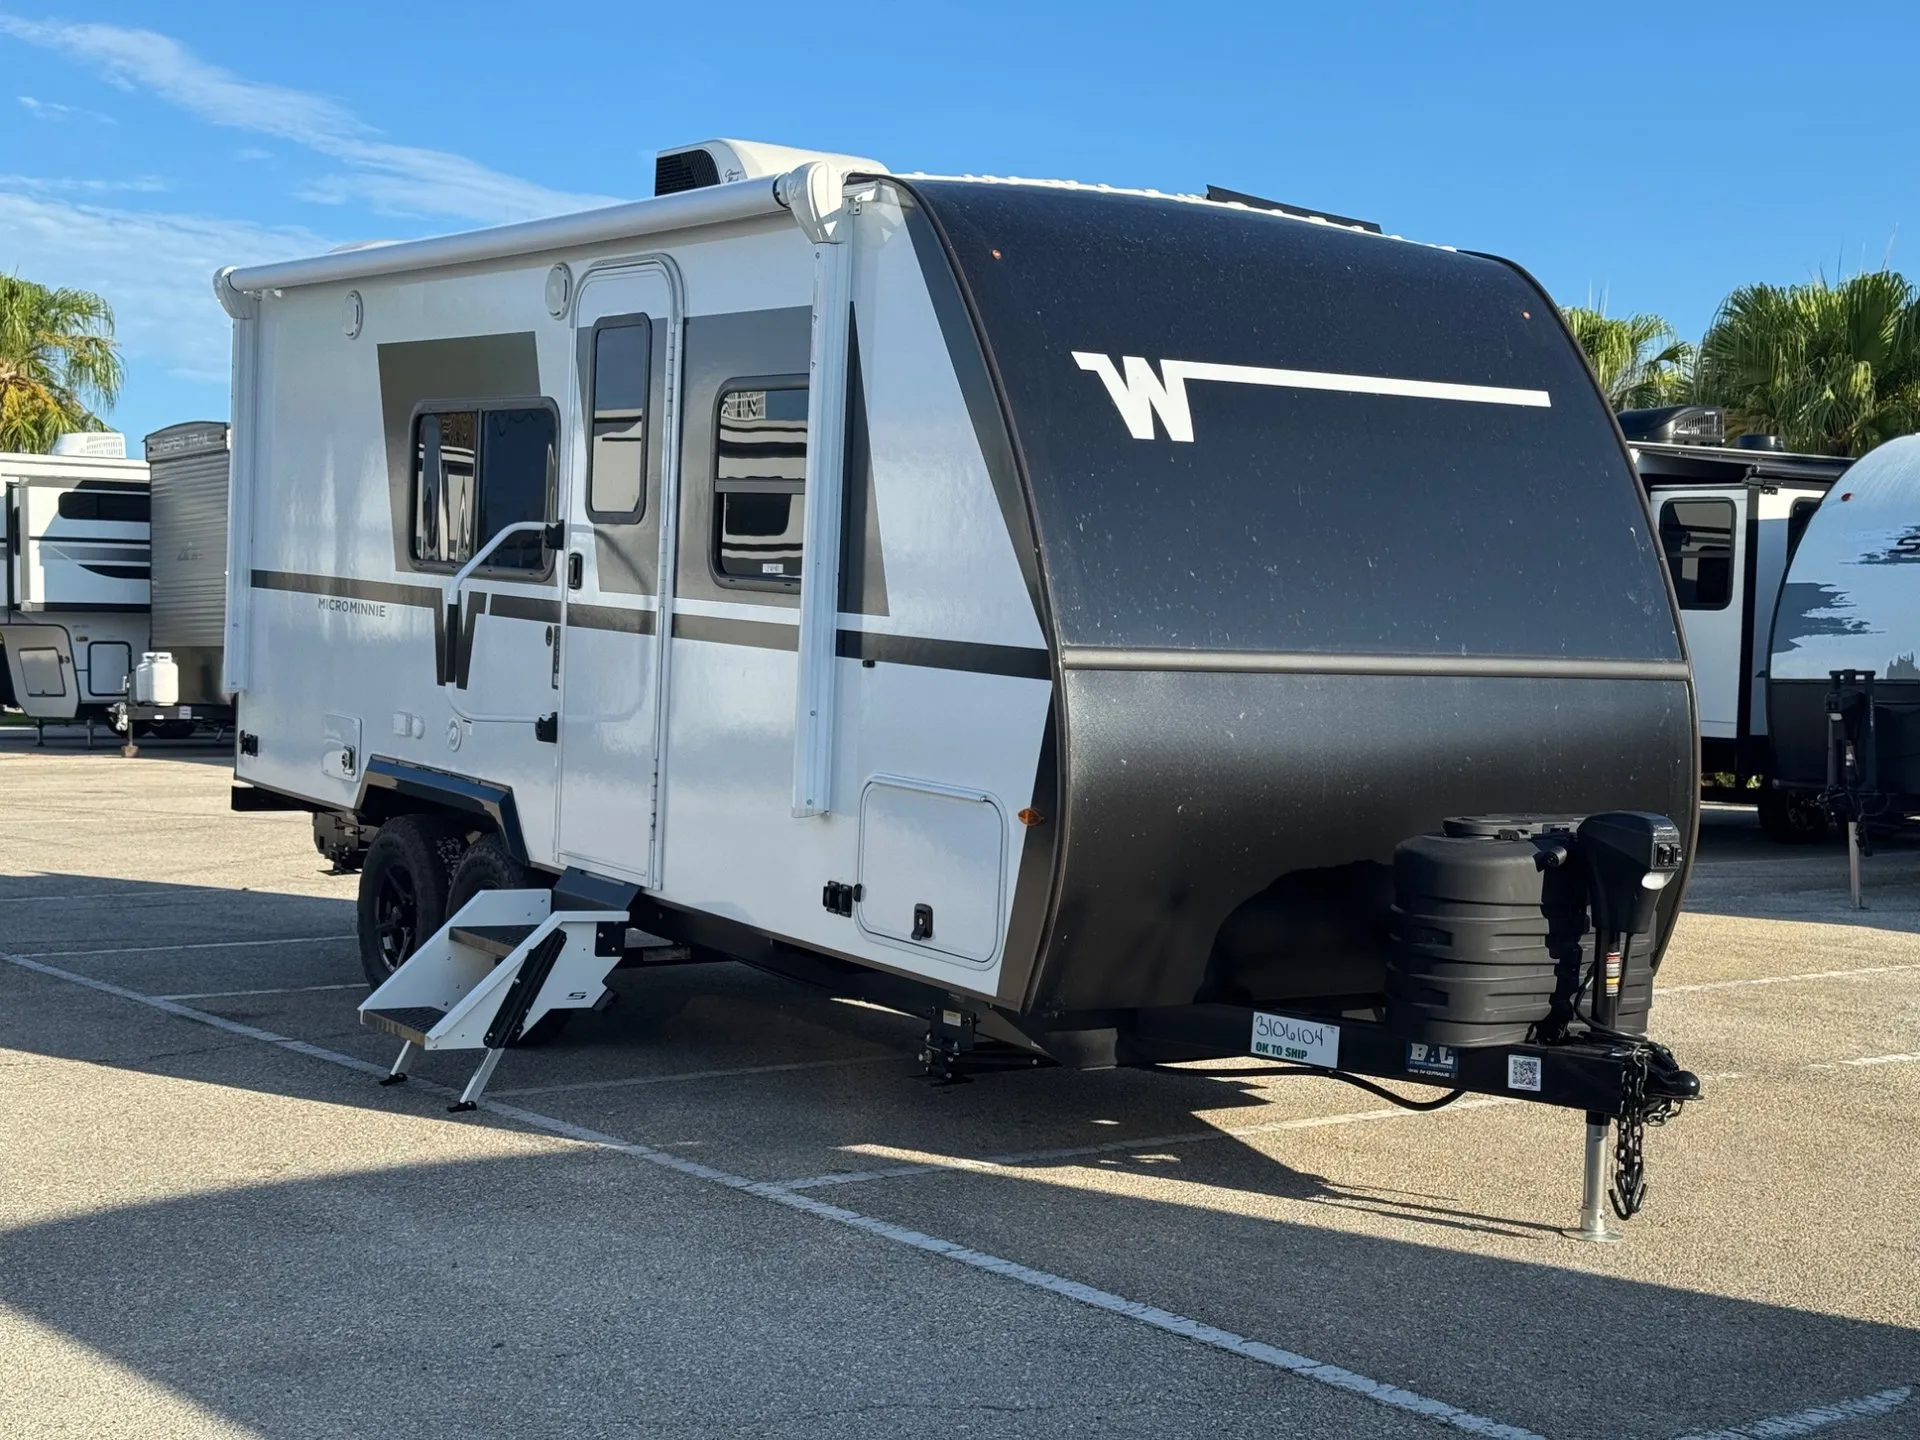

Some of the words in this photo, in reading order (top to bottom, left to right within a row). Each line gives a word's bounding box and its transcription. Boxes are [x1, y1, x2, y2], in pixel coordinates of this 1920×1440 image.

[317, 597, 386, 617] MICROMINNIE
[1255, 1015, 1324, 1047] 3106104
[1255, 1041, 1269, 1054] OK
[1271, 1044, 1283, 1056] TO
[1285, 1046, 1308, 1060] SHIP
